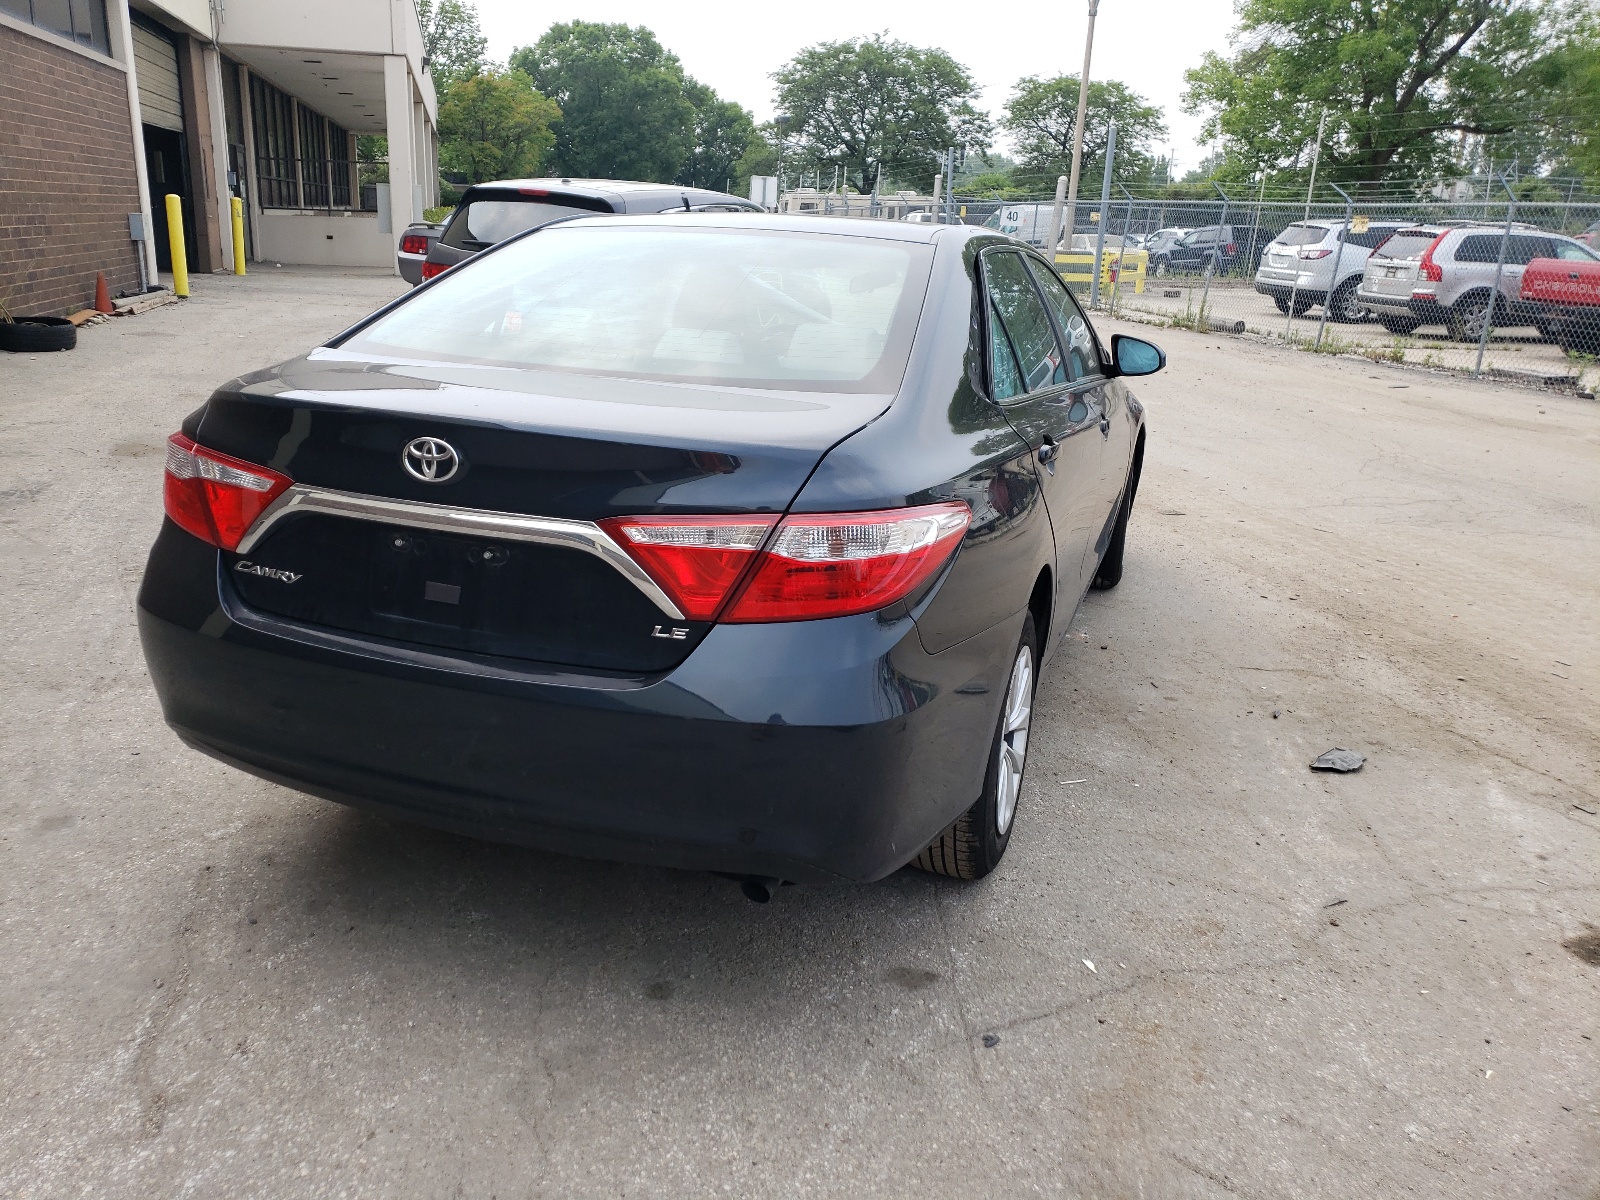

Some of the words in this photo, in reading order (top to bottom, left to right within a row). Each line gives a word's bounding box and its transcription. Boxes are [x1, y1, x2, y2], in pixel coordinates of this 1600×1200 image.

[1006, 211, 1018, 222] 40
[234, 560, 303, 584] CAMRY
[650, 625, 690, 640] LE
